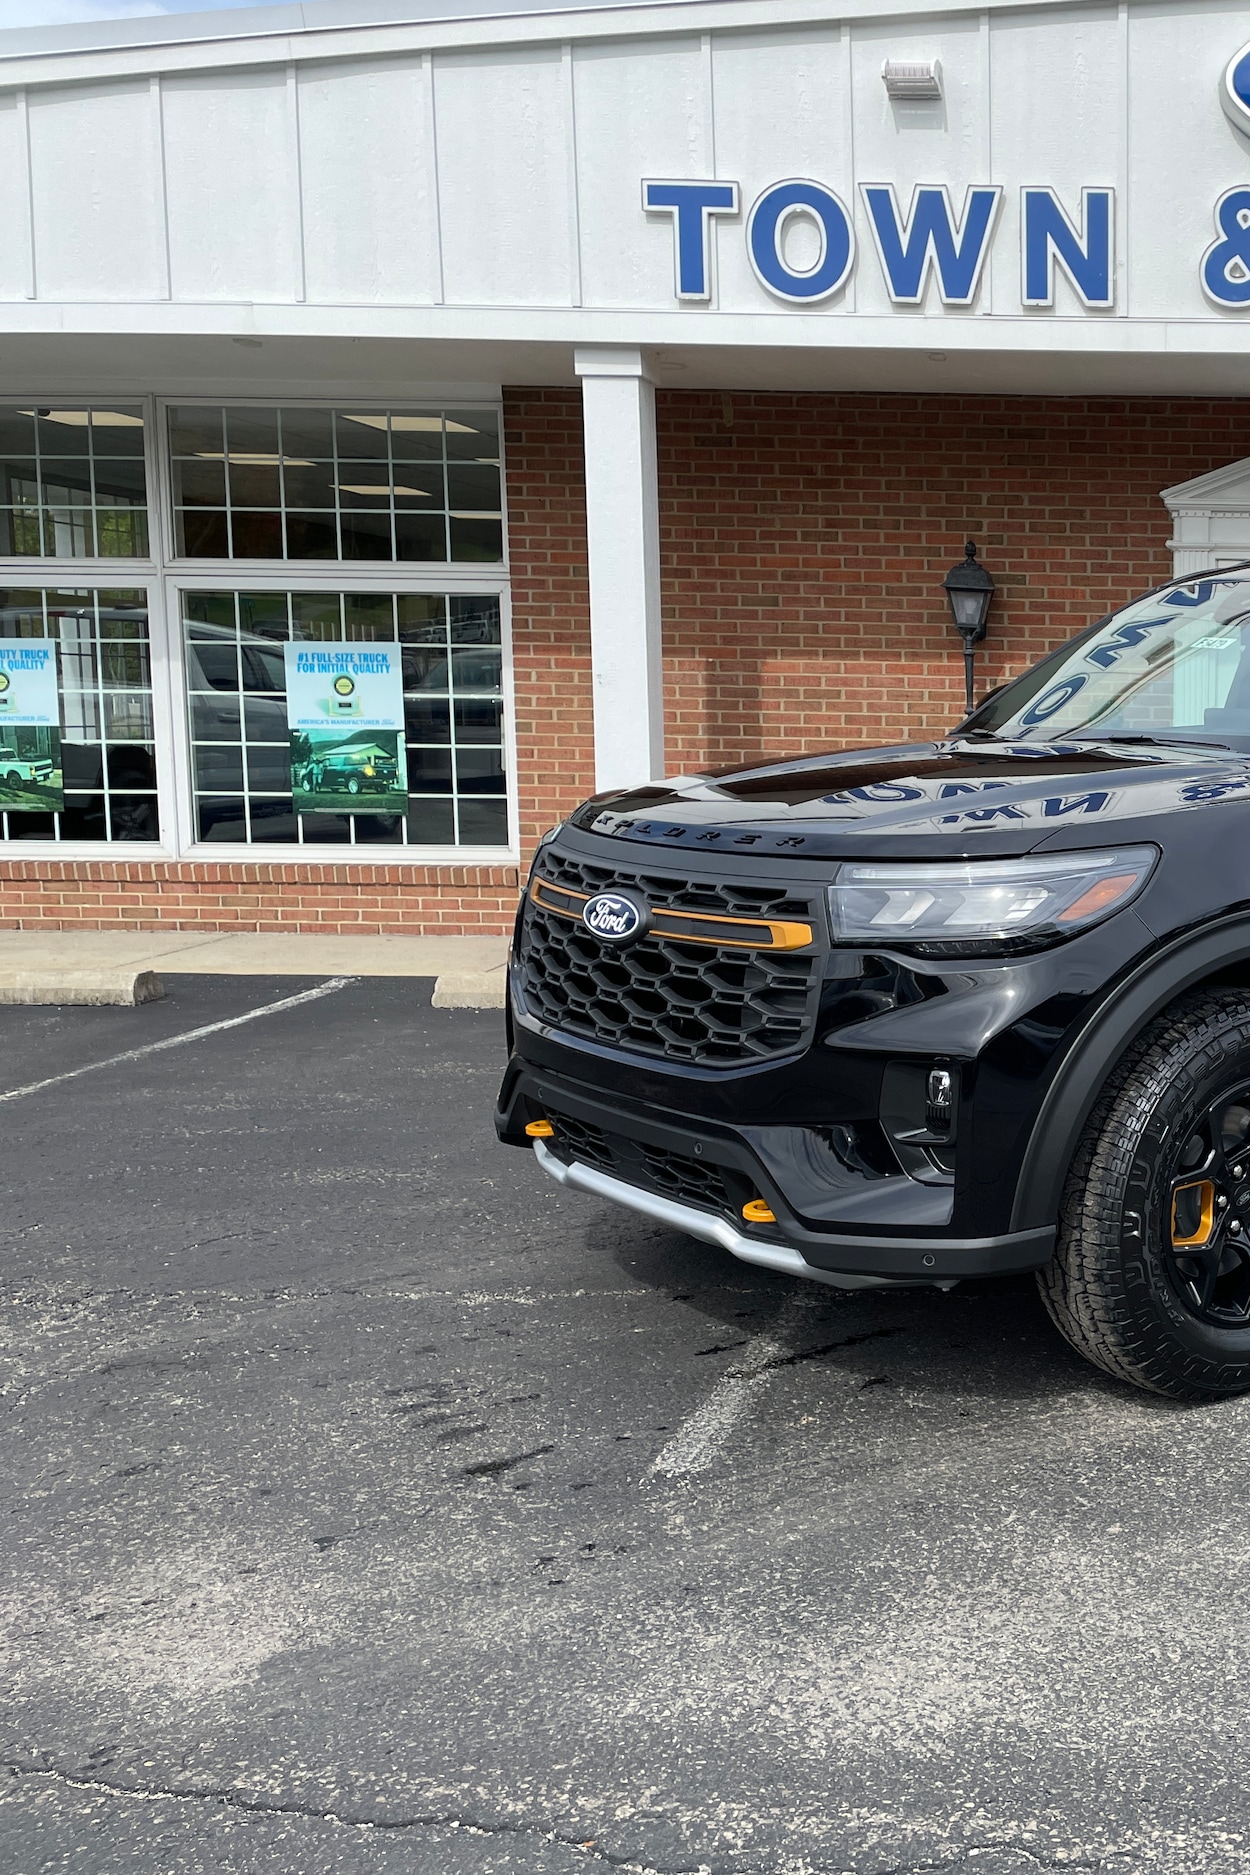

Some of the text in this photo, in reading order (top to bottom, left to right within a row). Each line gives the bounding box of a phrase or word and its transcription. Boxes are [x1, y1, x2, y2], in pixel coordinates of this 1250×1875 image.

[641, 178, 1115, 307] TOWN
[19, 649, 49, 659] TRUCK
[298, 653, 388, 663] #1 FULL-SIZE TRUCK
[8, 660, 45, 671] QUALITY
[297, 663, 390, 675] FOR INITIAL QUALITY
[580, 811, 806, 848] EXPLORER
[589, 899, 627, 933] Ford
